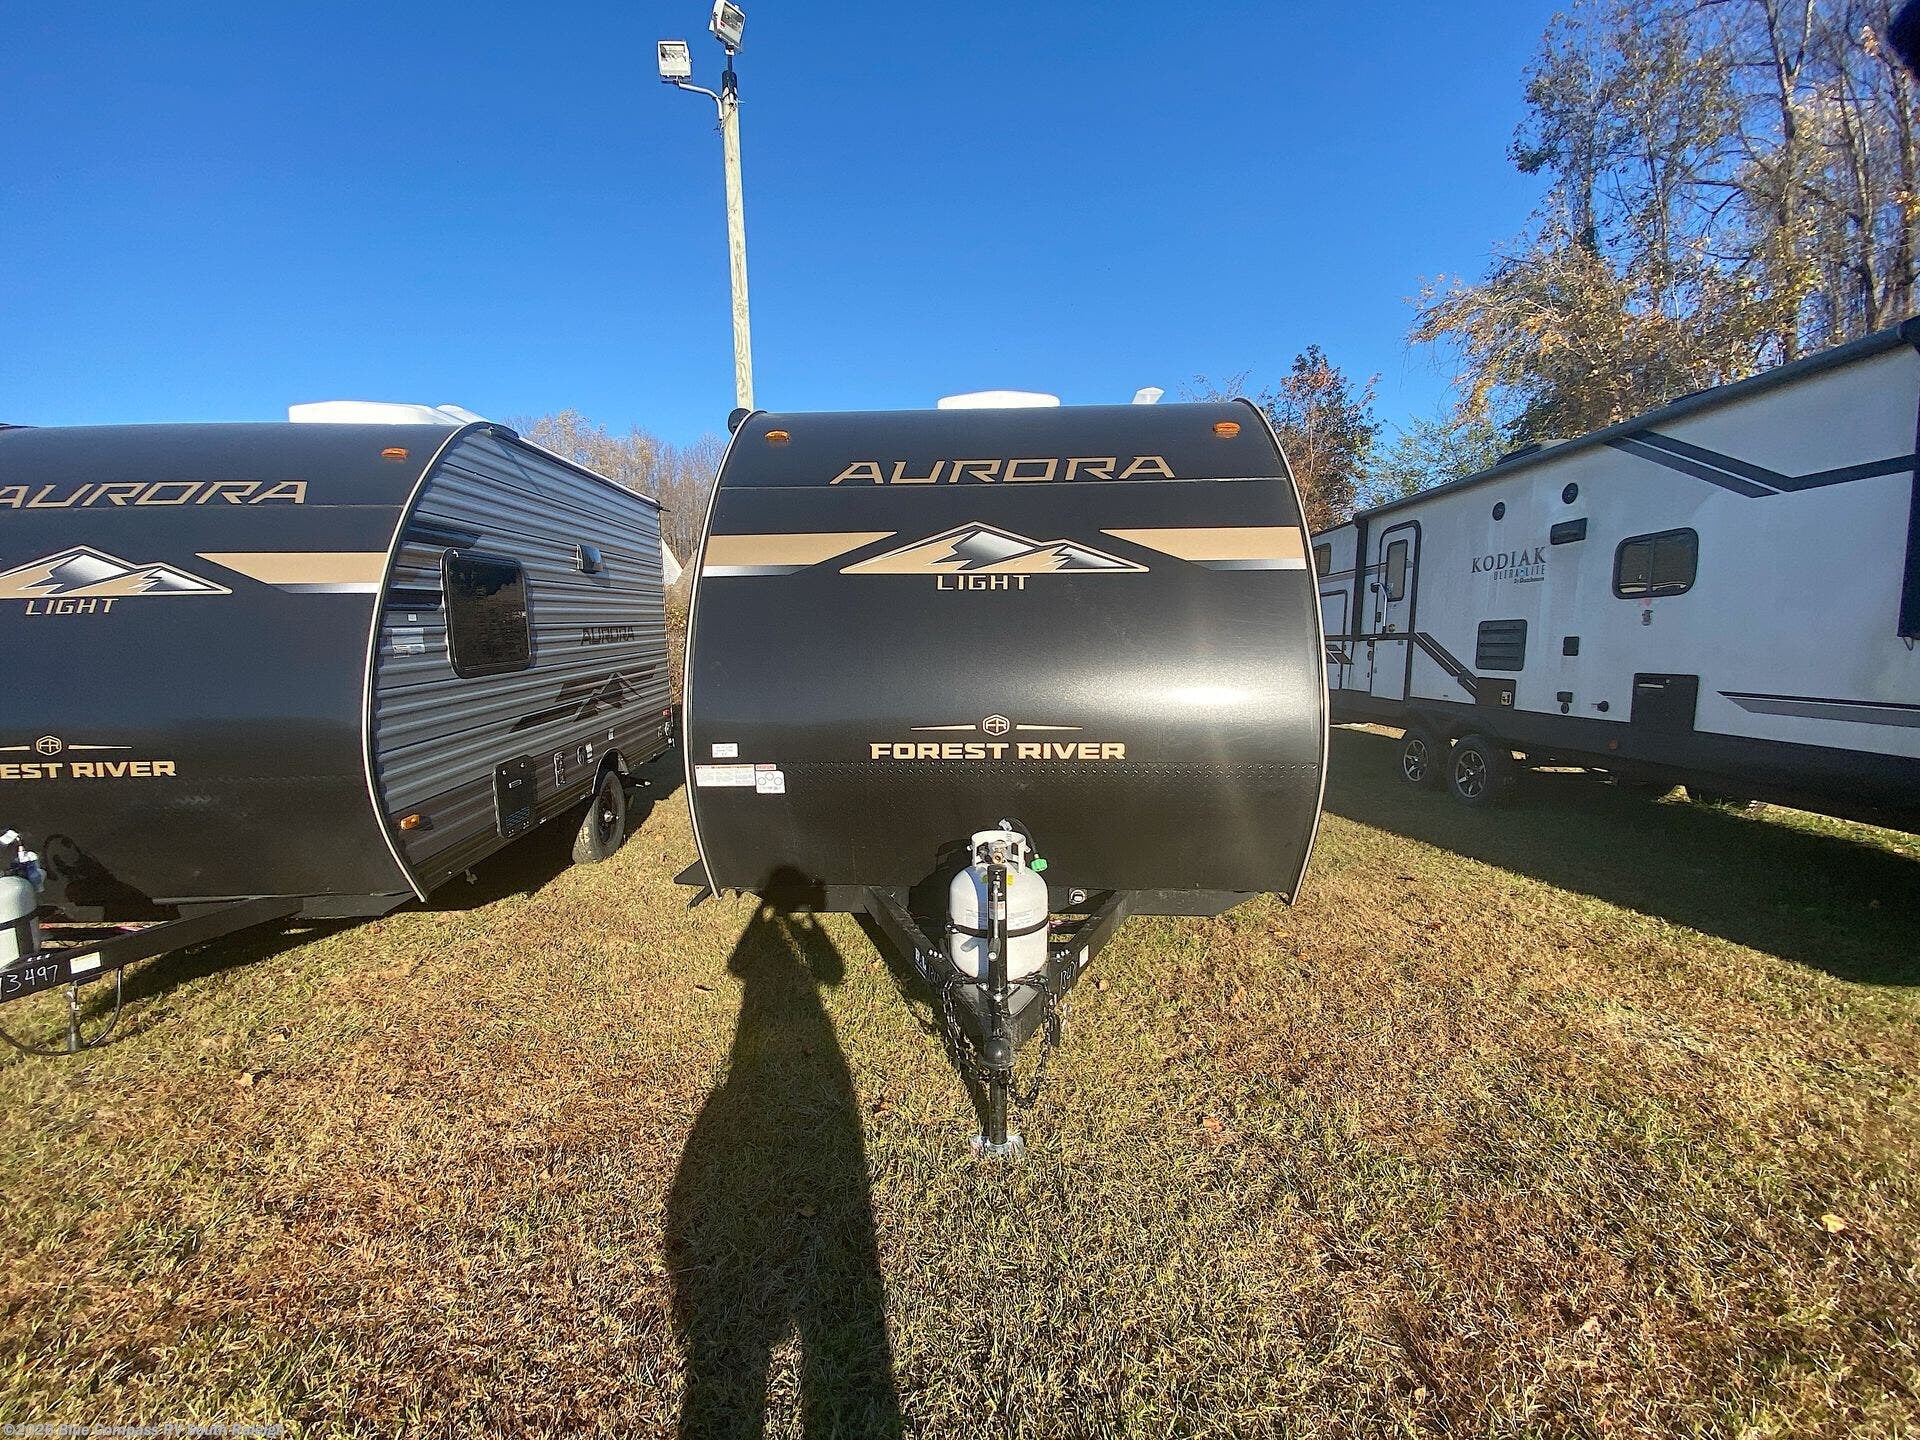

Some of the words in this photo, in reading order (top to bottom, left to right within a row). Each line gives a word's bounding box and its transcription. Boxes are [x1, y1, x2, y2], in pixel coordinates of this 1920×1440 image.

[830, 455, 1175, 485] AURORA
[0, 480, 308, 509] AURORA
[1471, 546, 1546, 573] KODIAK
[936, 574, 1031, 590] LIGHT
[25, 598, 119, 616] LIGHT
[580, 626, 635, 646] AURORA
[869, 742, 1010, 760] FOREST
[1016, 742, 1126, 760] RIVER
[69, 760, 177, 778] RIVER
[0, 964, 59, 1000] 3497
